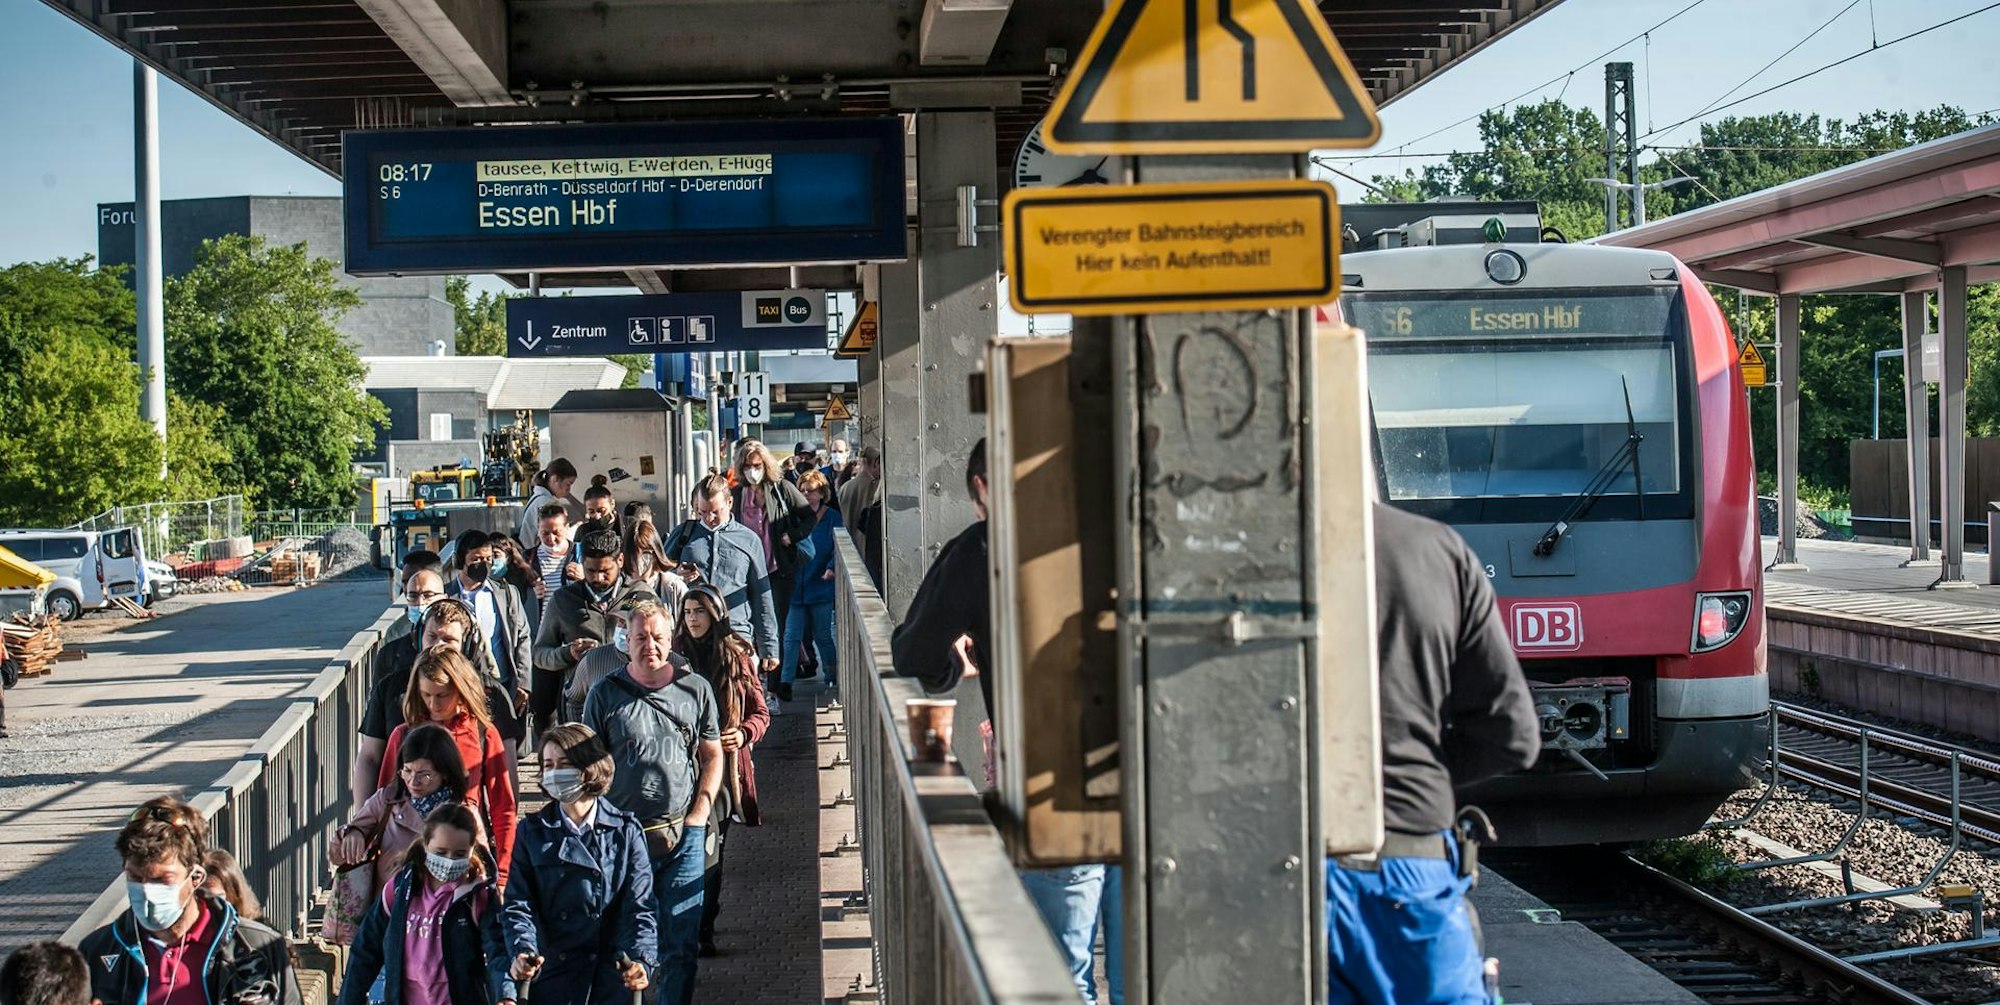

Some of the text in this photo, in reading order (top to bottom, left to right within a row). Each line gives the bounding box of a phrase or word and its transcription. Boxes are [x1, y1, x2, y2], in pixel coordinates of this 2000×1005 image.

[379, 163, 433, 182] 08:17
[483, 162, 547, 177] tausee,
[551, 160, 624, 177] Kettwig,
[628, 158, 714, 174] E-Werden,
[380, 185, 401, 200] S 6
[478, 182, 548, 197] D-Benrath
[561, 179, 638, 195] Düsseldorf
[641, 178, 666, 193] Hbf
[680, 176, 764, 192] D-Derendorf
[100, 207, 138, 225] Foru
[478, 198, 618, 228] Essen Hbf
[1039, 218, 1305, 248] Verengter Bahnsteigbereich
[1075, 248, 1271, 272] Hier kein Aufenthalt!
[758, 305, 808, 316] TAXI Bus
[1470, 307, 1540, 331] Essen
[1543, 304, 1583, 330] Hbf
[551, 324, 607, 339] Zentrum
[743, 374, 764, 396] 11
[748, 397, 761, 418] 8
[1520, 610, 1573, 643] DB
